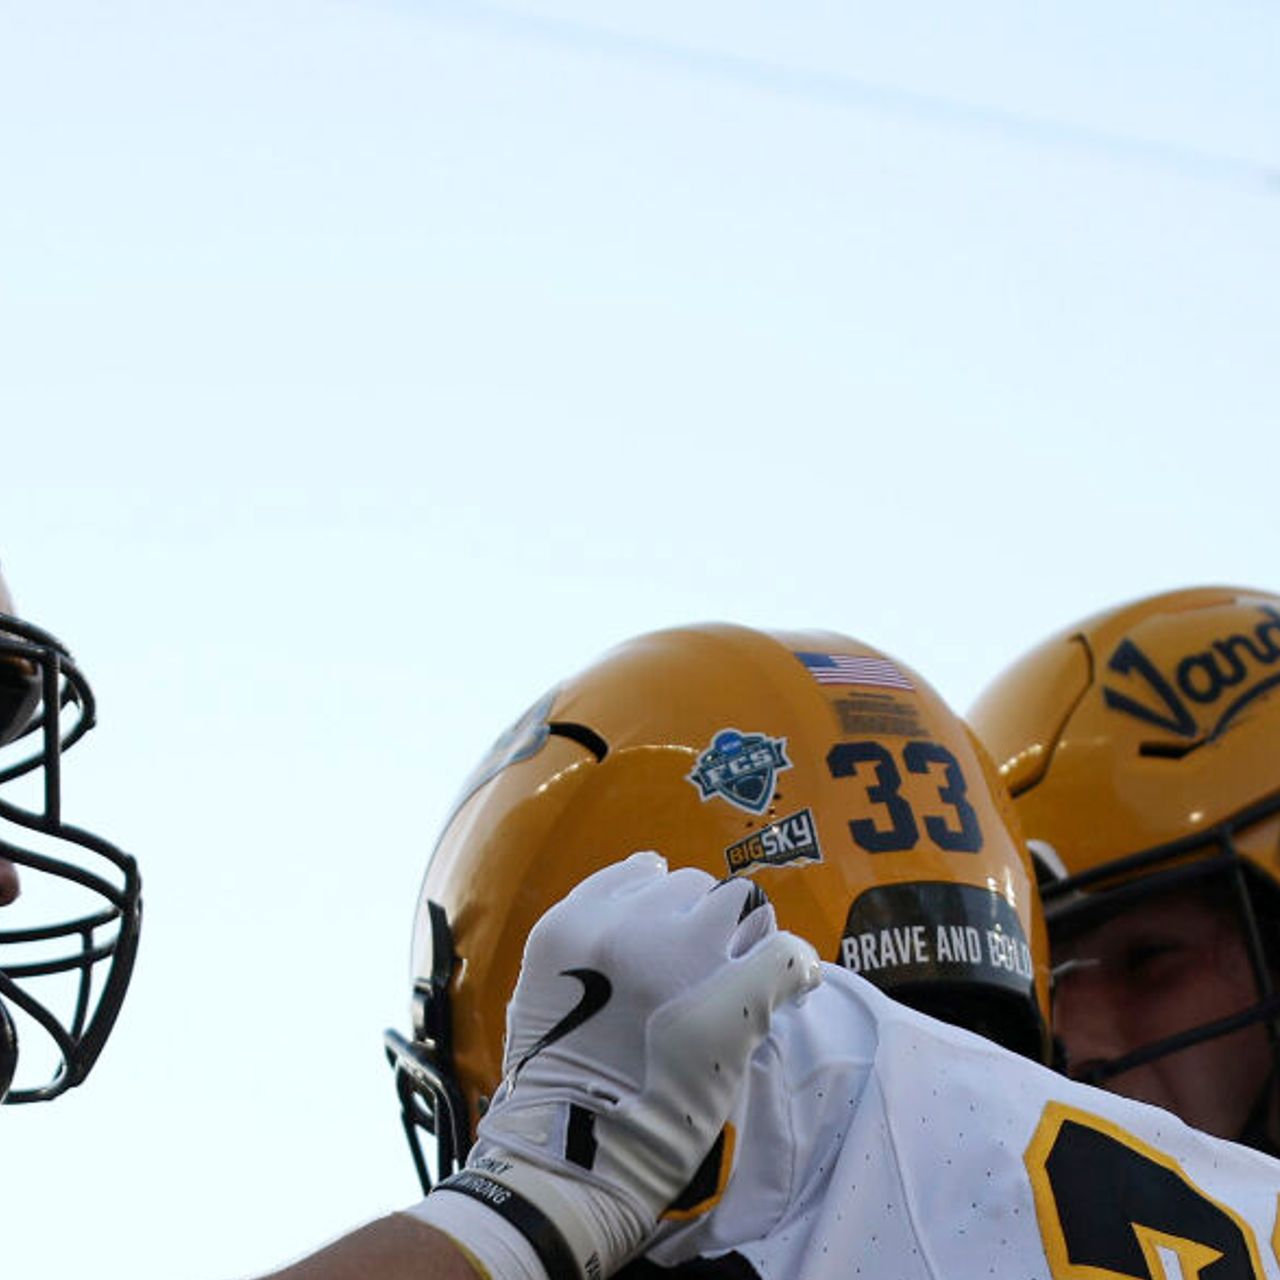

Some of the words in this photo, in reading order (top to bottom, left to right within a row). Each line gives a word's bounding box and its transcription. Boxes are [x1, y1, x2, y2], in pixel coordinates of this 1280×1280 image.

[826, 741, 984, 853] 33
[841, 925, 929, 973] BRAVE
[936, 924, 983, 965] AND
